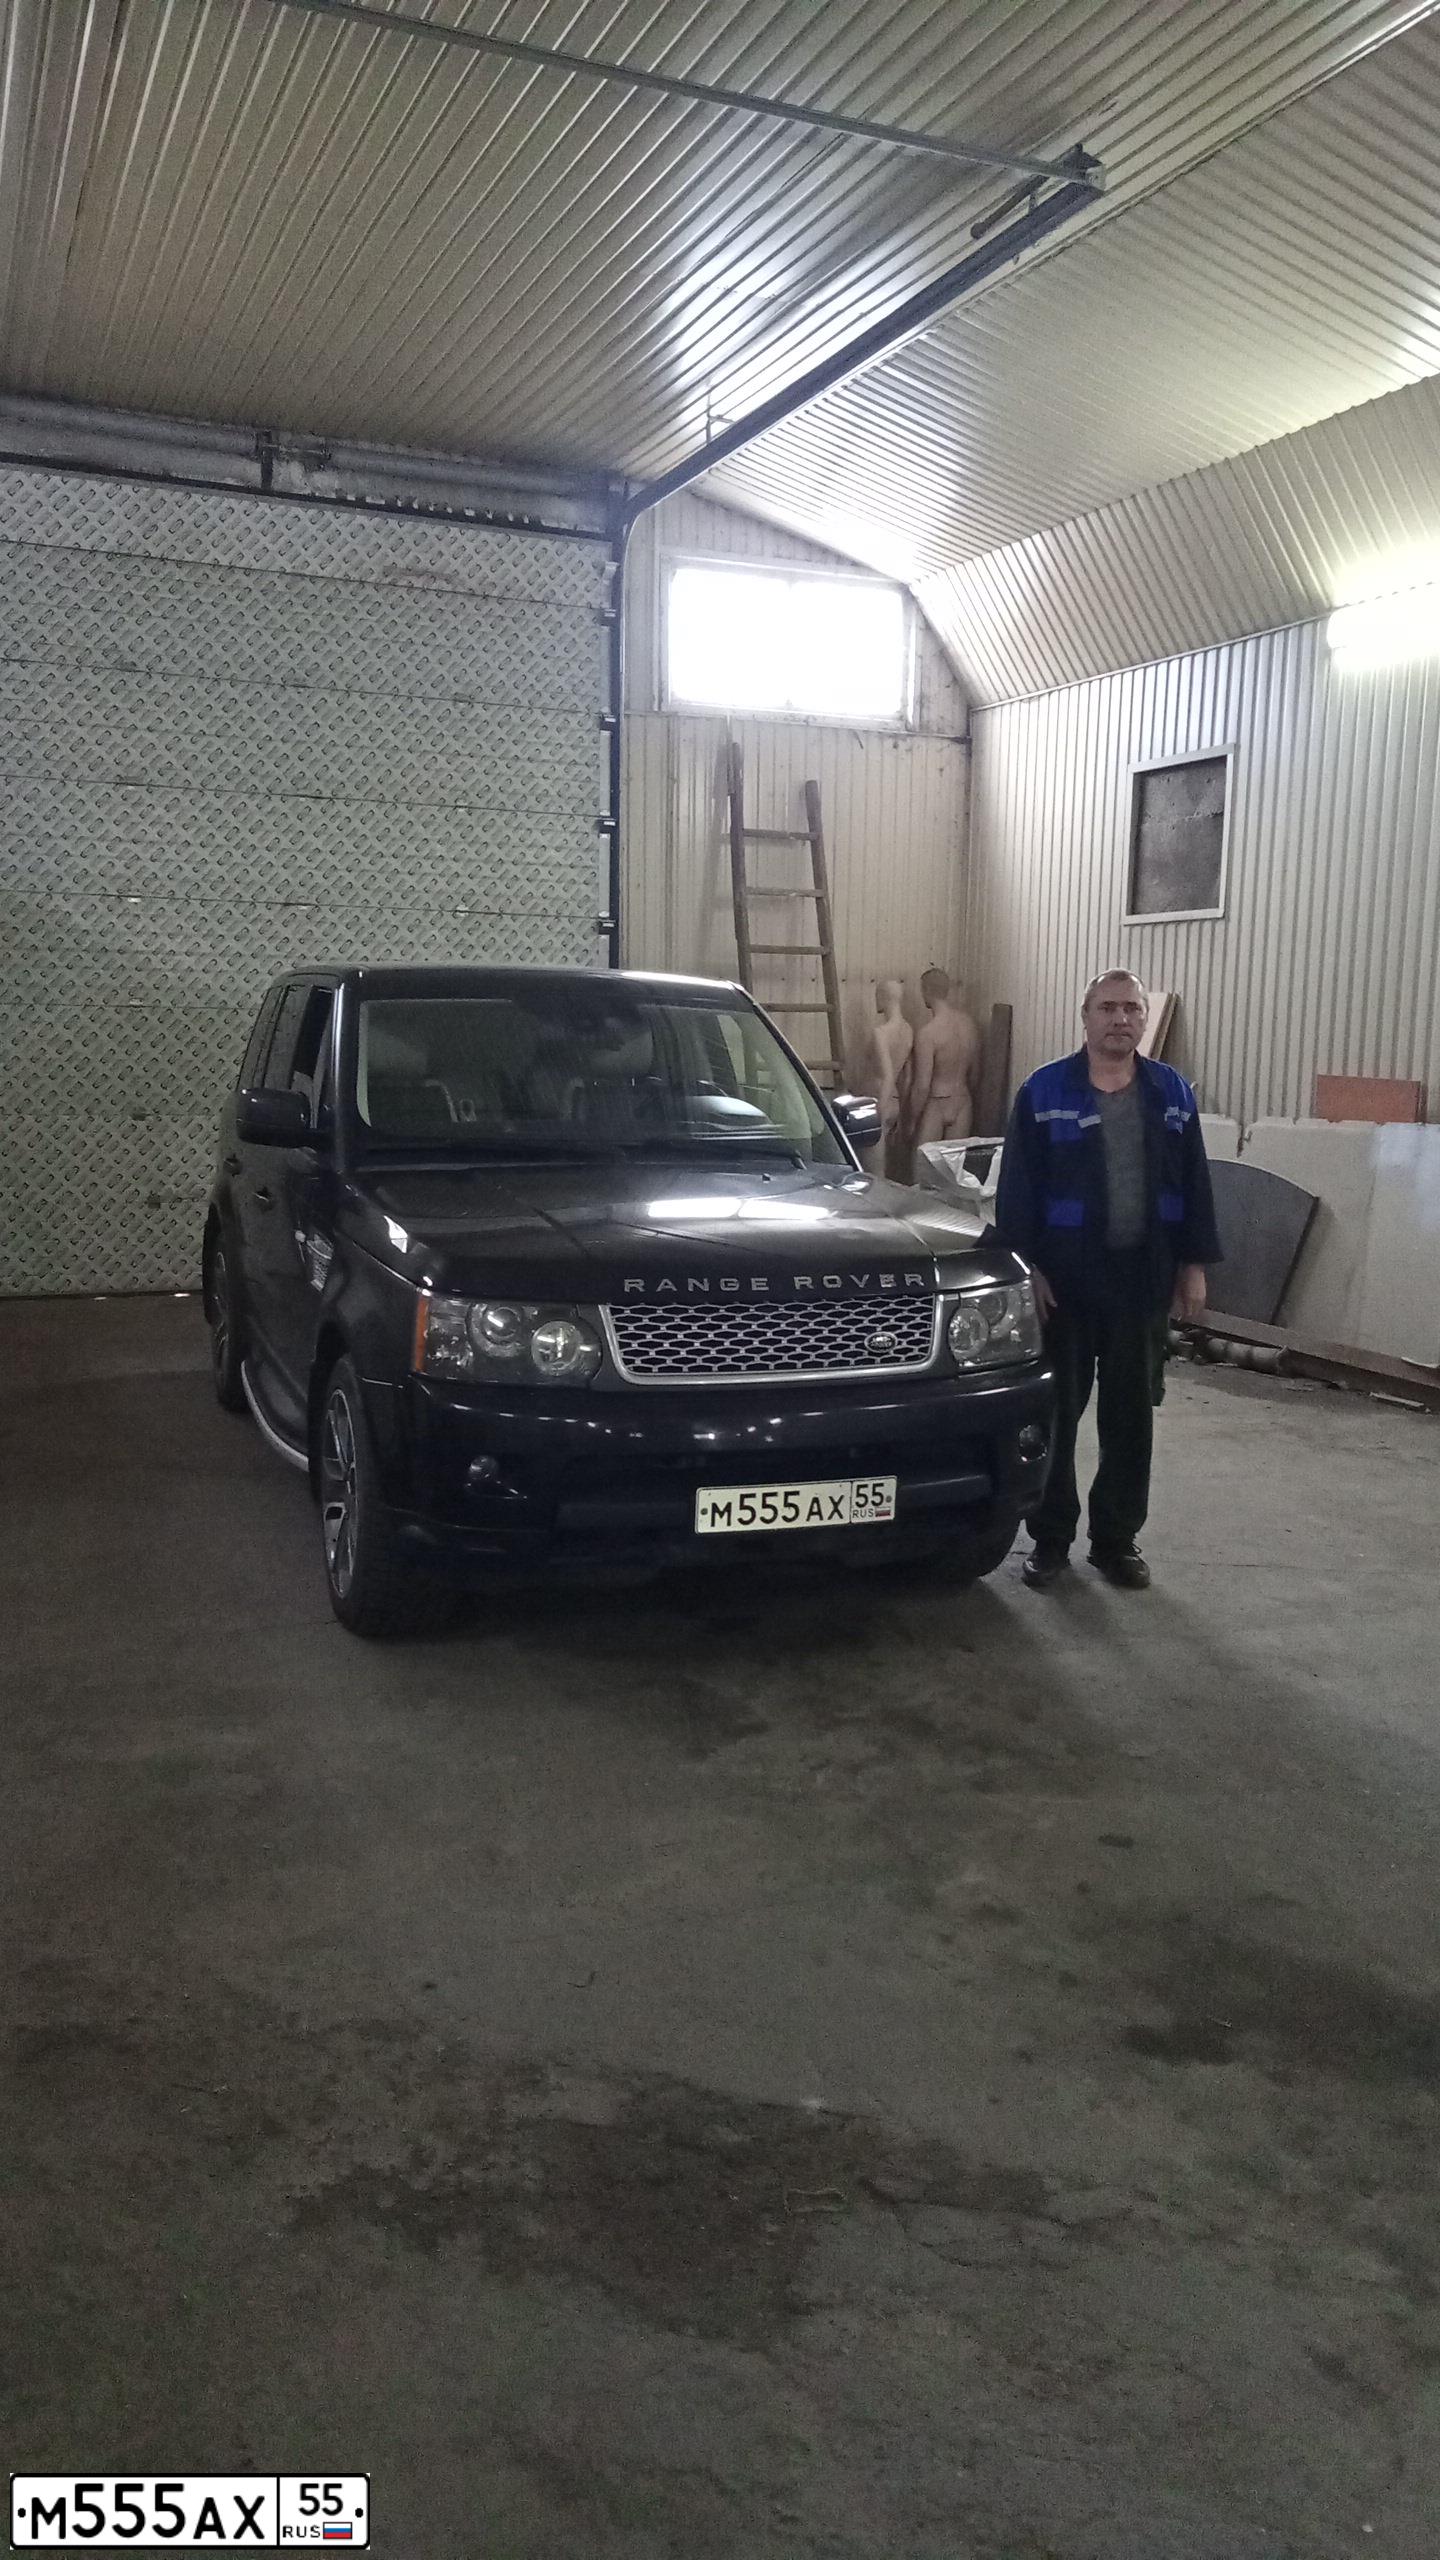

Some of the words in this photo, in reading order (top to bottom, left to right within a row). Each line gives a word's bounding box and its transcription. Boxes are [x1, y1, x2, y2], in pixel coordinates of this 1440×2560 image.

[623, 1277, 770, 1293] RANGE
[793, 1273, 925, 1290] ROVER
[854, 1482, 886, 1509] 55
[852, 1508, 875, 1519] RUS
